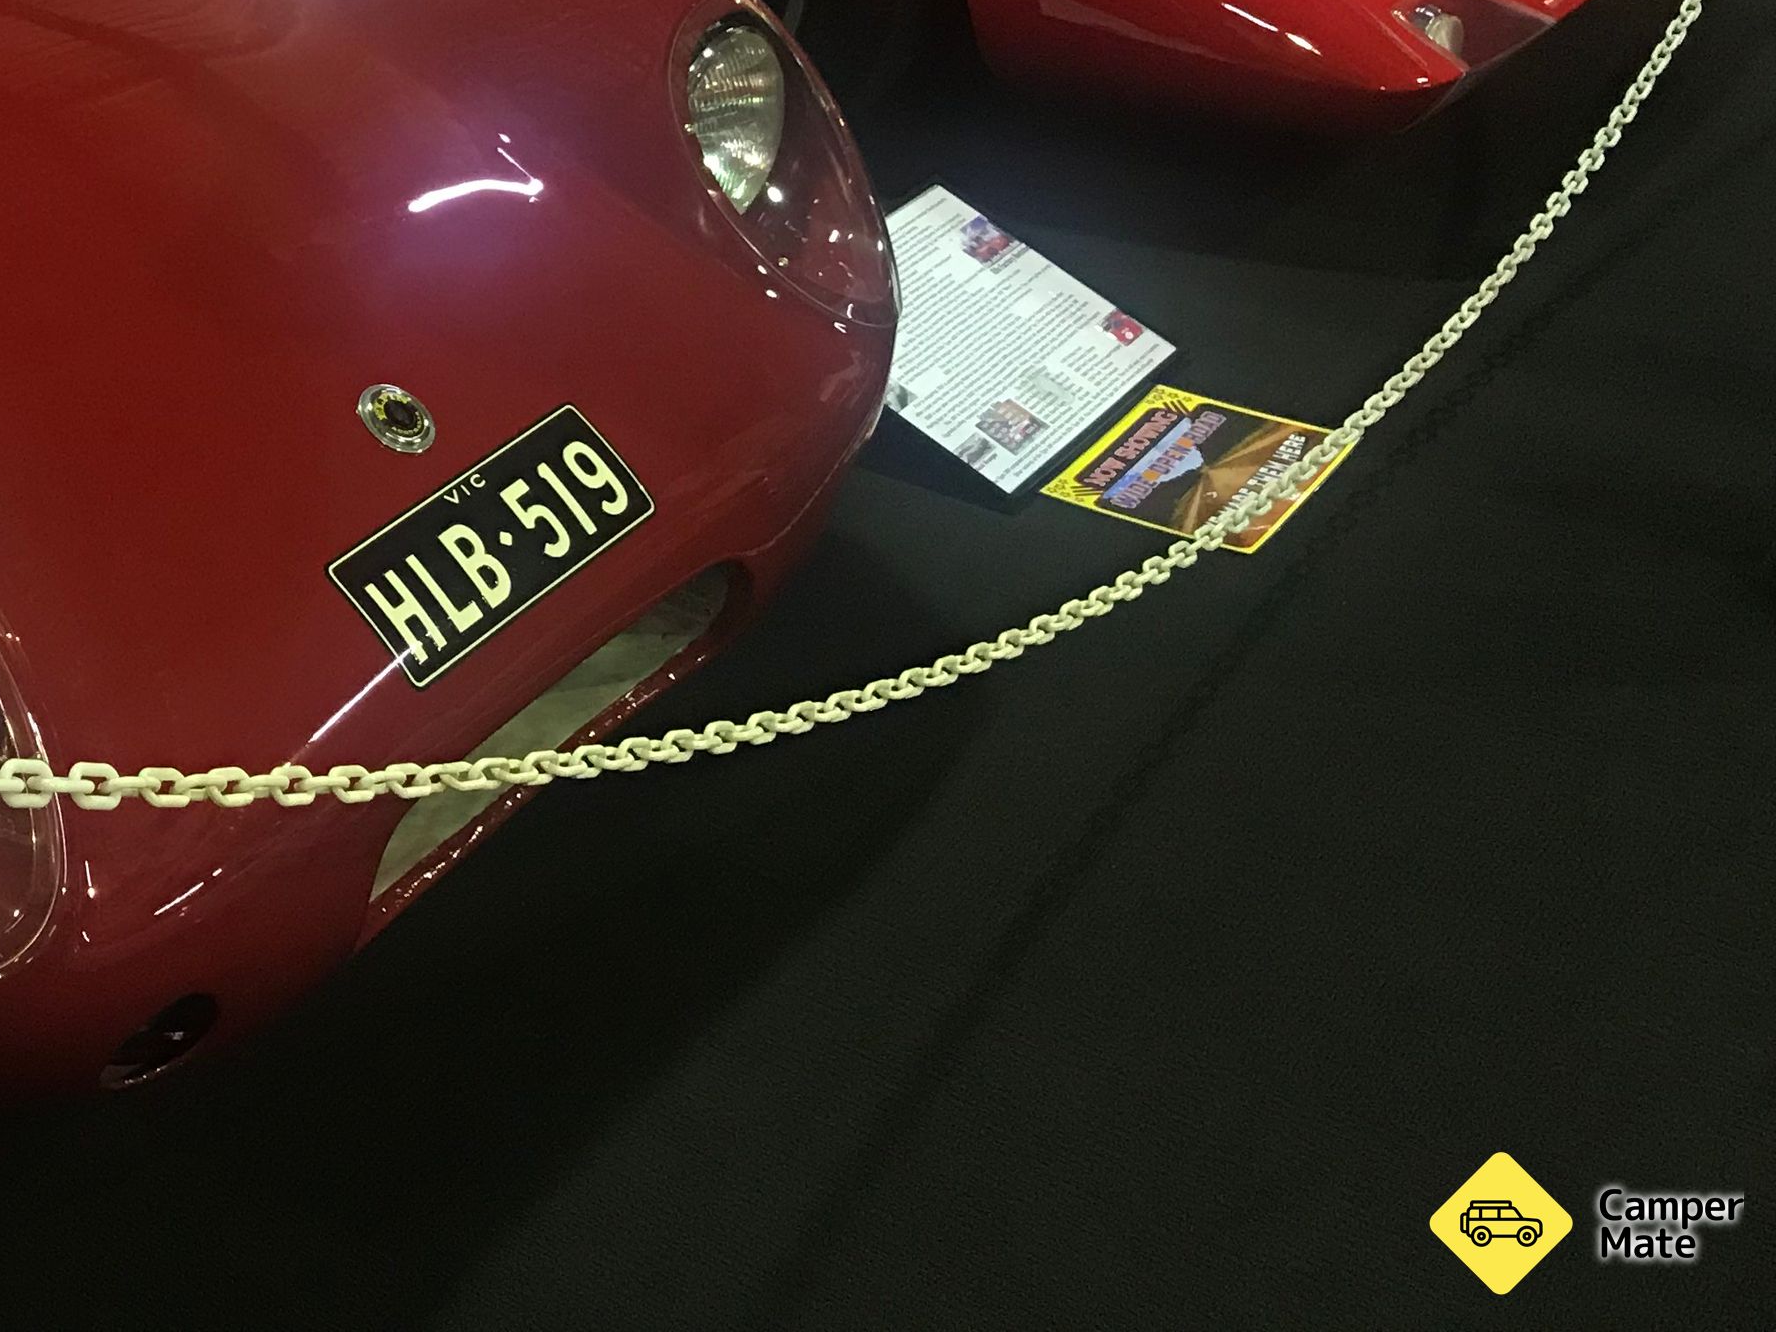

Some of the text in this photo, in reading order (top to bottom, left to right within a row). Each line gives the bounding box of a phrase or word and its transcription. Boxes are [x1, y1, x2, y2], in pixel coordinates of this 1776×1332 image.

[1083, 456, 1126, 487] NOW
[1114, 410, 1178, 460] SHOWING
[1110, 472, 1157, 509] WIDE
[1190, 411, 1227, 445] ROAD
[1271, 433, 1307, 460] HERE
[443, 473, 487, 505] VIC
